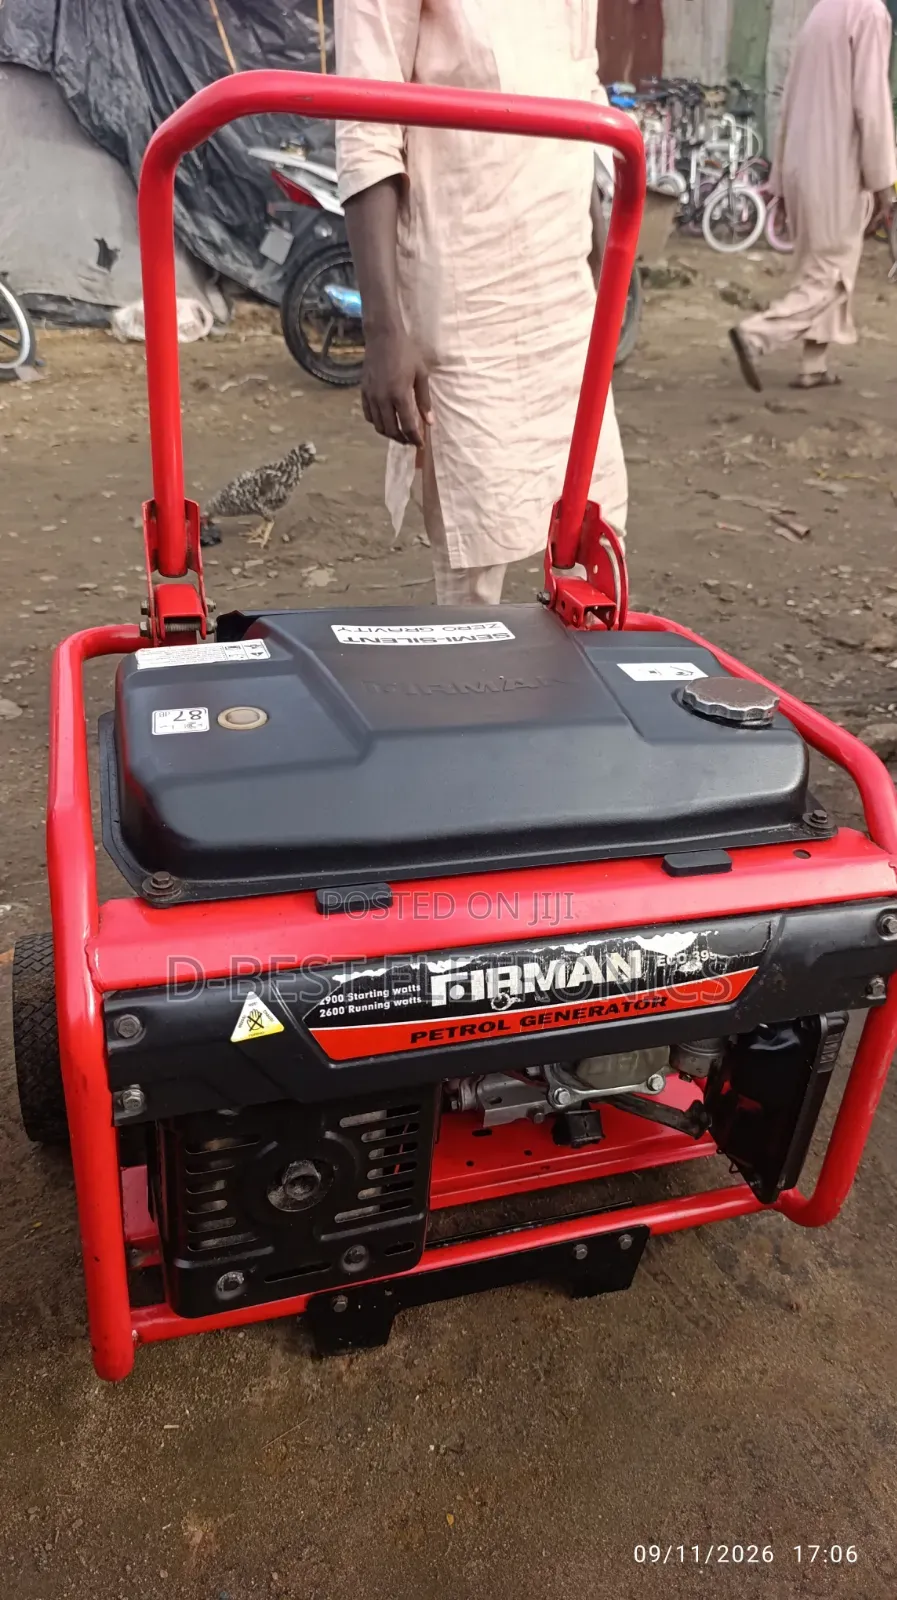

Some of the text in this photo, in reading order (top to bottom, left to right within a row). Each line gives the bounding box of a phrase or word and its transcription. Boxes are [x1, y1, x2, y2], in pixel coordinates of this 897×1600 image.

[442, 624, 502, 632] ZERO
[343, 632, 511, 644] SEMI-SILENT
[173, 710, 203, 722] 87
[430, 950, 642, 1007] FIRMAN
[347, 989, 390, 1002] Starting
[392, 984, 421, 996] watts
[319, 996, 422, 1018] 2600 Running watts
[410, 996, 667, 1044] PETROL GENERATOR
